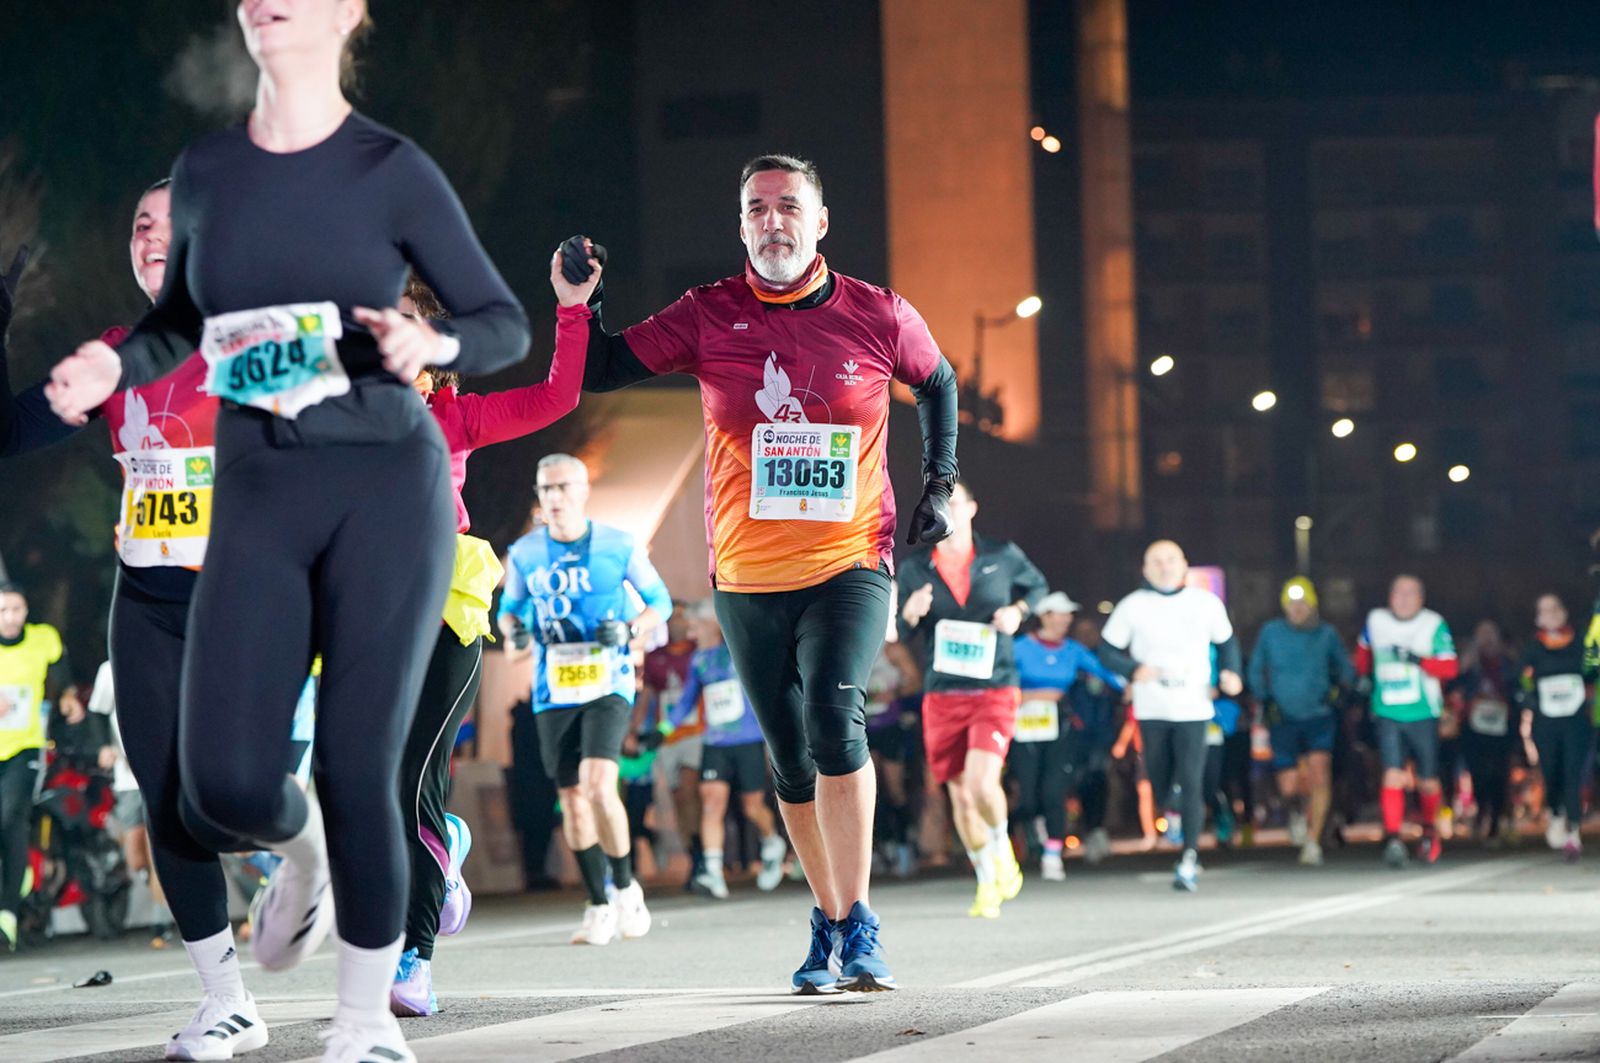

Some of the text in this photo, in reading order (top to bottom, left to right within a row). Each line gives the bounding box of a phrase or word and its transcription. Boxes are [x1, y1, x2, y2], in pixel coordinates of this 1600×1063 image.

[775, 435, 822, 445] NOCHE DE
[764, 446, 785, 457] SAN
[786, 444, 821, 457] ANTÓN
[160, 463, 173, 474] DE
[764, 458, 845, 489] 13053
[136, 491, 199, 527] 5743
